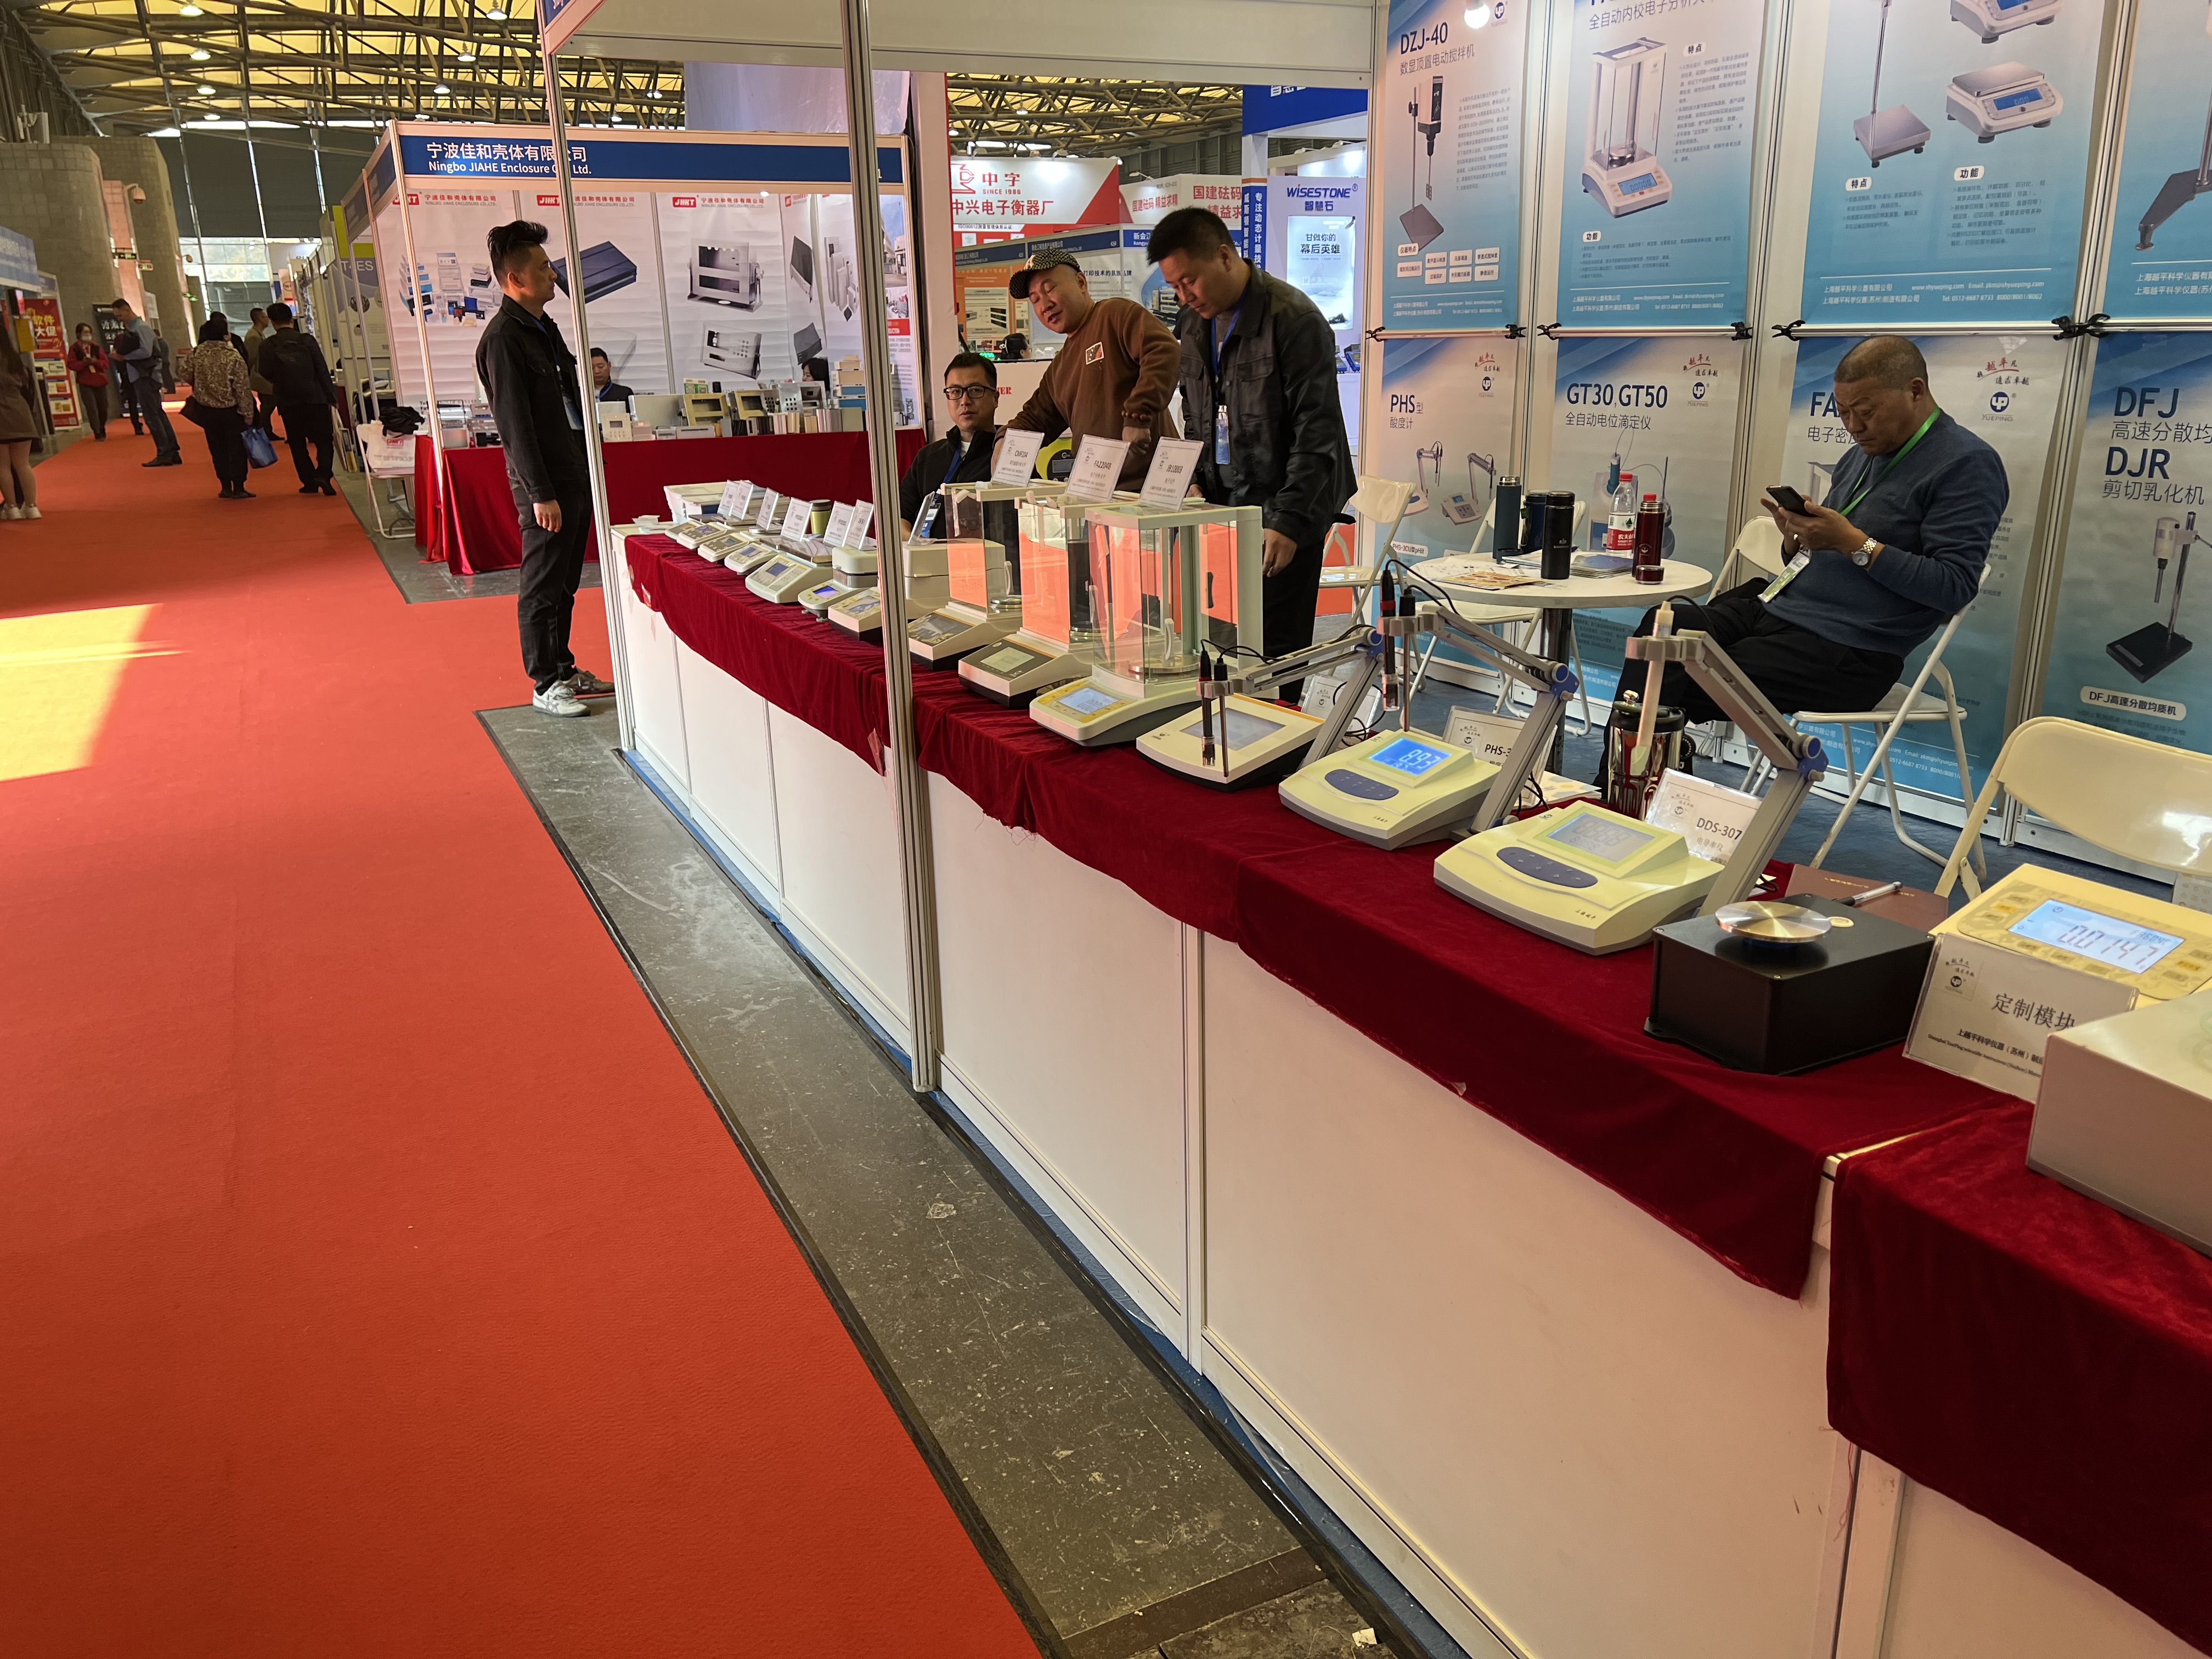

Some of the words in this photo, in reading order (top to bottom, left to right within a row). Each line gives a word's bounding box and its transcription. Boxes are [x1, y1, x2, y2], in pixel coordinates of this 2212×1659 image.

[1401, 22, 1448, 54] DZJ-40
[1400, 44, 1475, 75] 数显顶置电动搅拌机
[428, 161, 466, 174] Ningbo
[469, 162, 499, 173] JIAHE
[501, 163, 550, 174] Enclosure
[573, 165, 592, 174] Ltd.
[1960, 168, 1979, 178] 功能
[1193, 186, 1242, 200] 国建砝码
[1851, 179, 1867, 189] 特点
[952, 199, 1053, 216] 中兴电子衡器厂
[1306, 233, 1336, 241] 甘做你的
[1300, 244, 1340, 254] 幕后英雄
[1810, 392, 1841, 417] FA
[2114, 387, 2180, 418] DFJ
[1390, 416, 1414, 429] 酸度计
[1565, 411, 1651, 430] 全自动电位滴定仪
[1982, 414, 2013, 422] YUEPING
[2112, 420, 2212, 444] 高速分散均
[2106, 447, 2170, 479] DJR
[2102, 479, 2205, 505] 剪切乳化机
[2089, 691, 2176, 716] DFJ高速分散均质机
[1696, 817, 1743, 840] DDS-307
[1696, 837, 1724, 852] 电导率仪
[1991, 994, 2075, 1031] 定制模块
